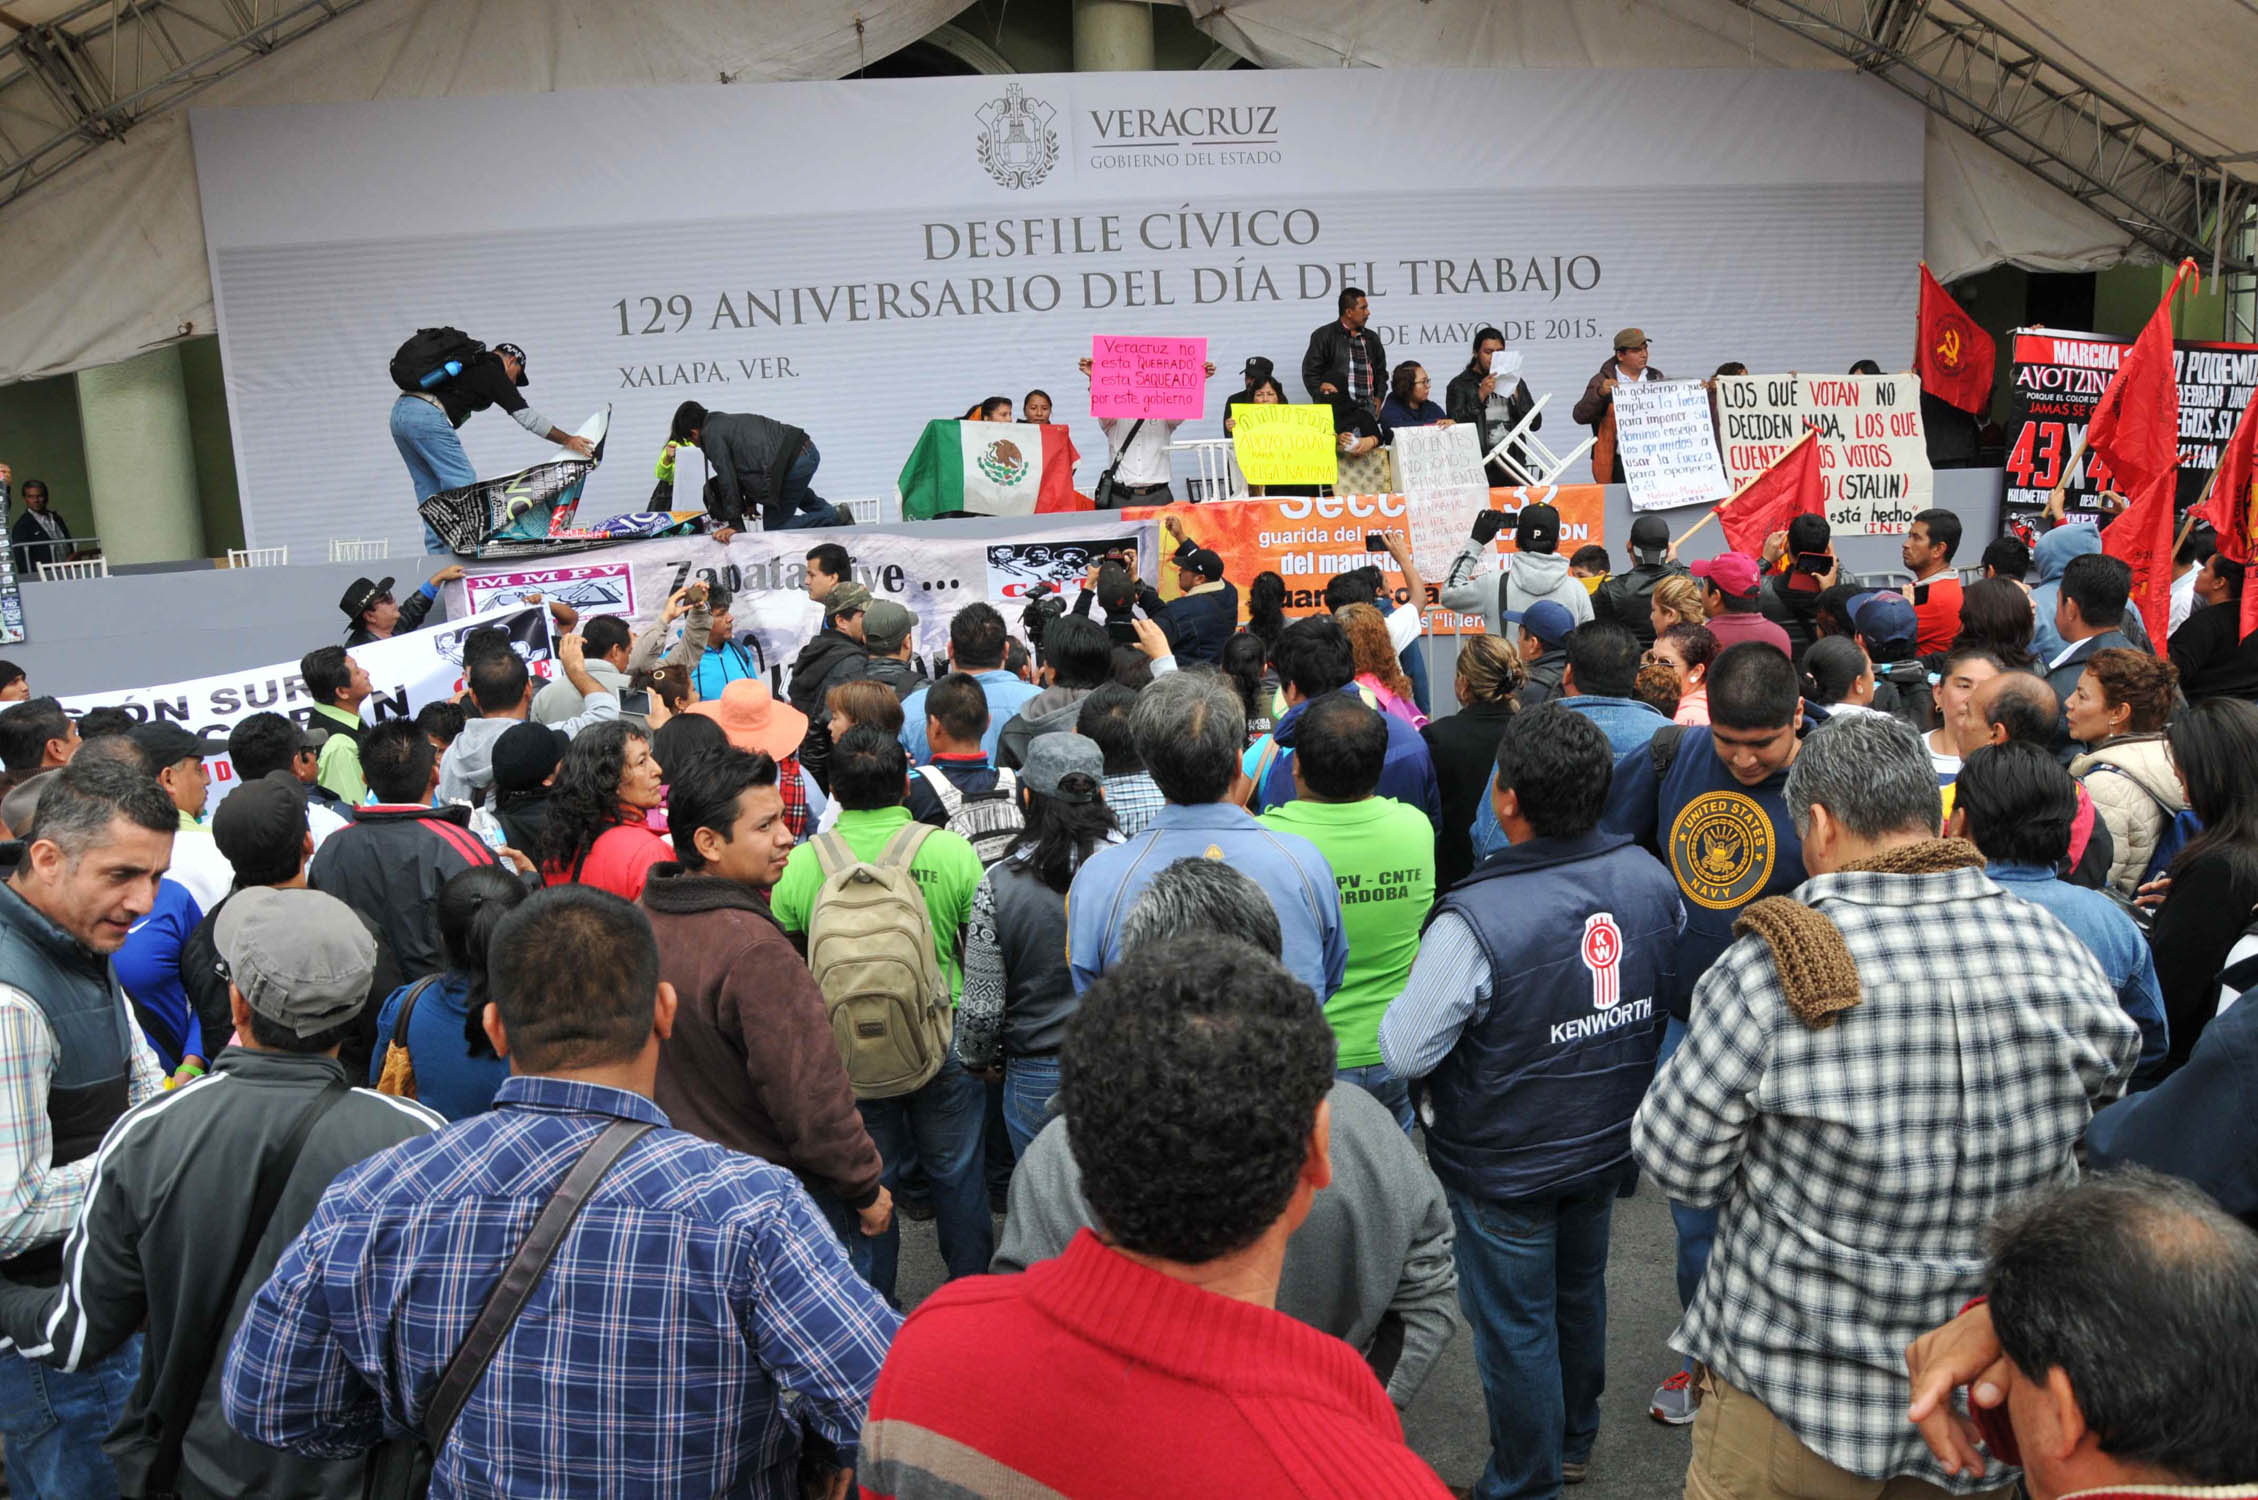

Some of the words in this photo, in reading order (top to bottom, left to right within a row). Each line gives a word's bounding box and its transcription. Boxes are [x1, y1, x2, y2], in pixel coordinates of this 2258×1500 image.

[1088, 106, 1279, 138] VERACRUZ
[1090, 153, 1179, 169] GOBIERNO
[1185, 151, 1215, 167] DEL
[1220, 149, 1282, 166] ESTADO
[922, 215, 1122, 261] DESFILE
[1139, 202, 1320, 251] CÍVICO
[612, 294, 692, 336] 129
[709, 273, 1061, 330] ANIVERSARIO
[1080, 268, 1176, 310] DEL
[1192, 256, 1282, 304] DÍA
[1297, 261, 1387, 299] DEL
[1399, 254, 1601, 302] TRABAJO
[1377, 325, 1410, 346] DE
[1504, 320, 1537, 341] DE
[1545, 318, 1604, 340] 2015.
[1104, 339, 1168, 354] Veracruz
[1179, 344, 1195, 355] no
[2053, 340, 2119, 368] MARCHA
[619, 361, 730, 389] XALAPA,
[738, 356, 800, 380] VER.
[1101, 358, 1130, 368] esta
[2186, 351, 2258, 386] PODEMO
[1101, 374, 1130, 385] esta
[1135, 371, 1197, 387] SAQUEADO
[1091, 394, 1109, 411] por
[1114, 390, 1139, 404] este
[1144, 391, 1192, 412] gobierno
[1613, 386, 1626, 396] Un
[1630, 383, 1678, 400] gobierno
[1722, 382, 1757, 408] LOS
[1768, 381, 1798, 407] QUE
[1809, 381, 1859, 407] VOTAN
[1876, 381, 1895, 406] NO
[2027, 391, 2053, 401] PORQUE
[2056, 392, 2064, 401] EL
[2066, 394, 2088, 403] COLOR
[2090, 395, 2098, 404] DE
[2176, 384, 2224, 407] LEBRAR
[1616, 397, 1654, 416] emplea
[1659, 395, 1672, 408] la
[1678, 394, 1706, 407] fuerza
[2029, 402, 2069, 415] JAMAS
[2073, 404, 2084, 416] SE
[1619, 417, 1642, 431] para
[1645, 411, 1686, 429] imponer
[1695, 410, 1708, 419] su
[1728, 414, 1792, 440] DECIDEN
[1856, 413, 1884, 439] LOS
[1891, 412, 1918, 437] QUE
[1620, 428, 1660, 442] dominio
[1703, 423, 1710, 432] a
[1622, 444, 1638, 454] los
[1642, 439, 1693, 456] oprimidos
[1701, 438, 1708, 446] a
[1731, 445, 1790, 470] CUENT
[1818, 444, 1835, 469] OS
[1842, 443, 1892, 468] VOTOS
[1625, 458, 1650, 468] usar
[1657, 453, 1670, 465] la
[1677, 452, 1712, 464] fuerza
[1629, 470, 1656, 484] para
[1663, 463, 1717, 478] oponerse
[1839, 473, 1908, 500] (STALIN)
[1830, 505, 1861, 523] está
[1258, 527, 1329, 548] guarida
[1334, 526, 1362, 542] del
[1533, 529, 1542, 540] P
[1281, 552, 1314, 575] del
[1684, 801, 1727, 828] UNITED
[1731, 803, 1765, 846] STATES
[1336, 874, 1361, 889] PV
[1379, 868, 1422, 886] CNTE
[1690, 878, 1731, 898] NAVY
[1339, 885, 1409, 905] RDOBA
[1550, 996, 1652, 1044] KENWORTH
